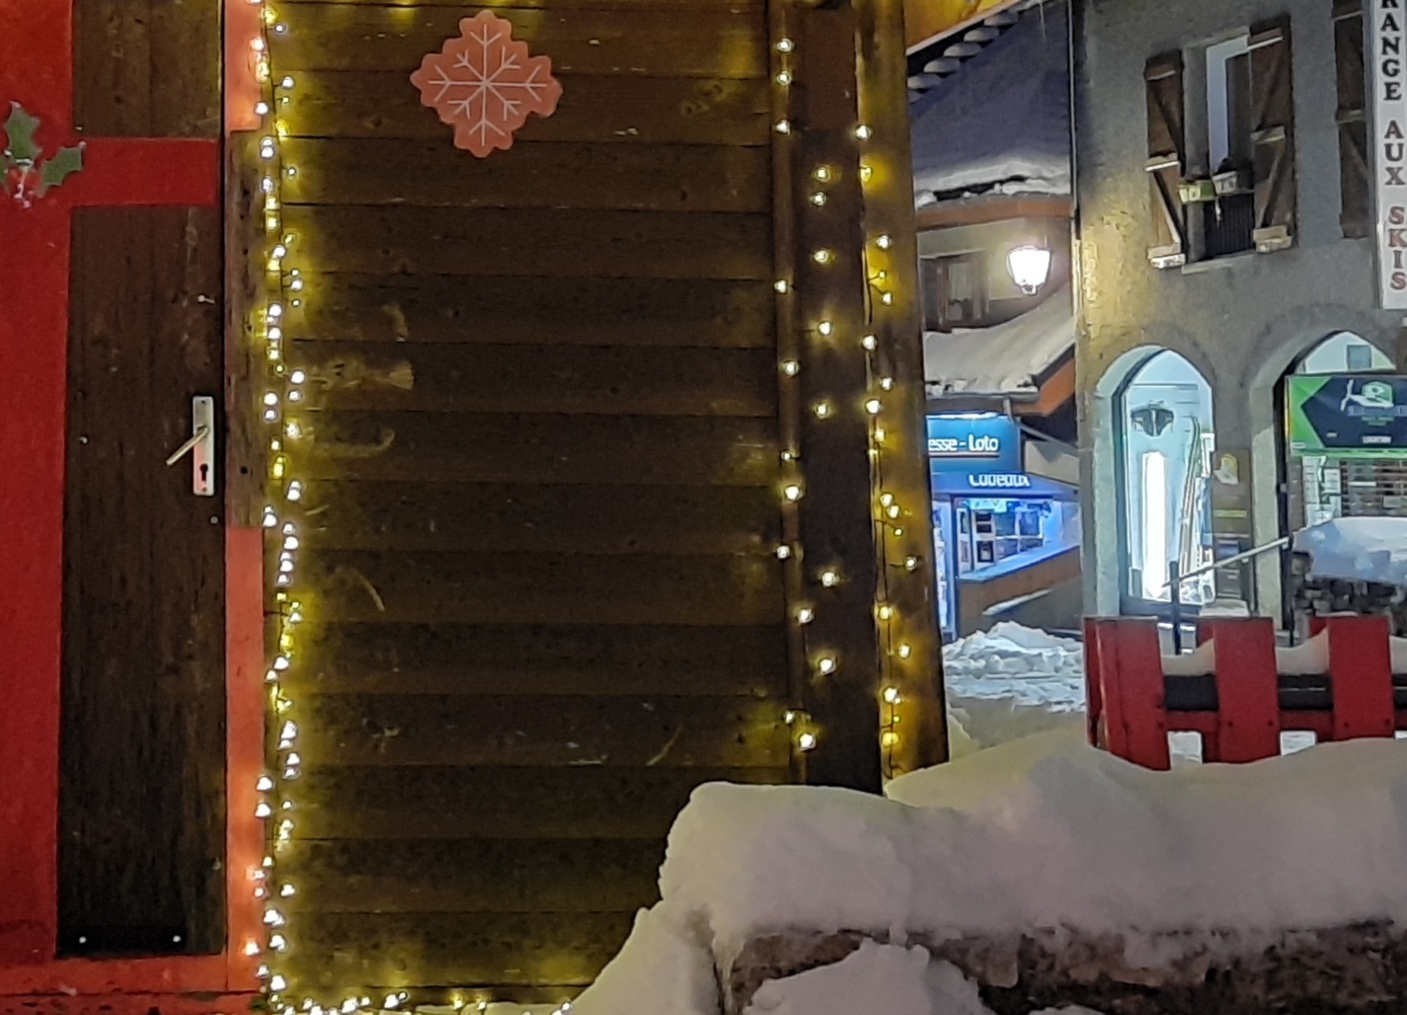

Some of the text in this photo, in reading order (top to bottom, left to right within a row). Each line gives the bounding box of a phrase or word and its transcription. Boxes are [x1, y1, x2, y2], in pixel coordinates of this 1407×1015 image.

[1384, 120, 1405, 185] AUX
[1388, 206, 1407, 290] SKIS
[928, 438, 958, 451] esse
[968, 433, 999, 451] Loto
